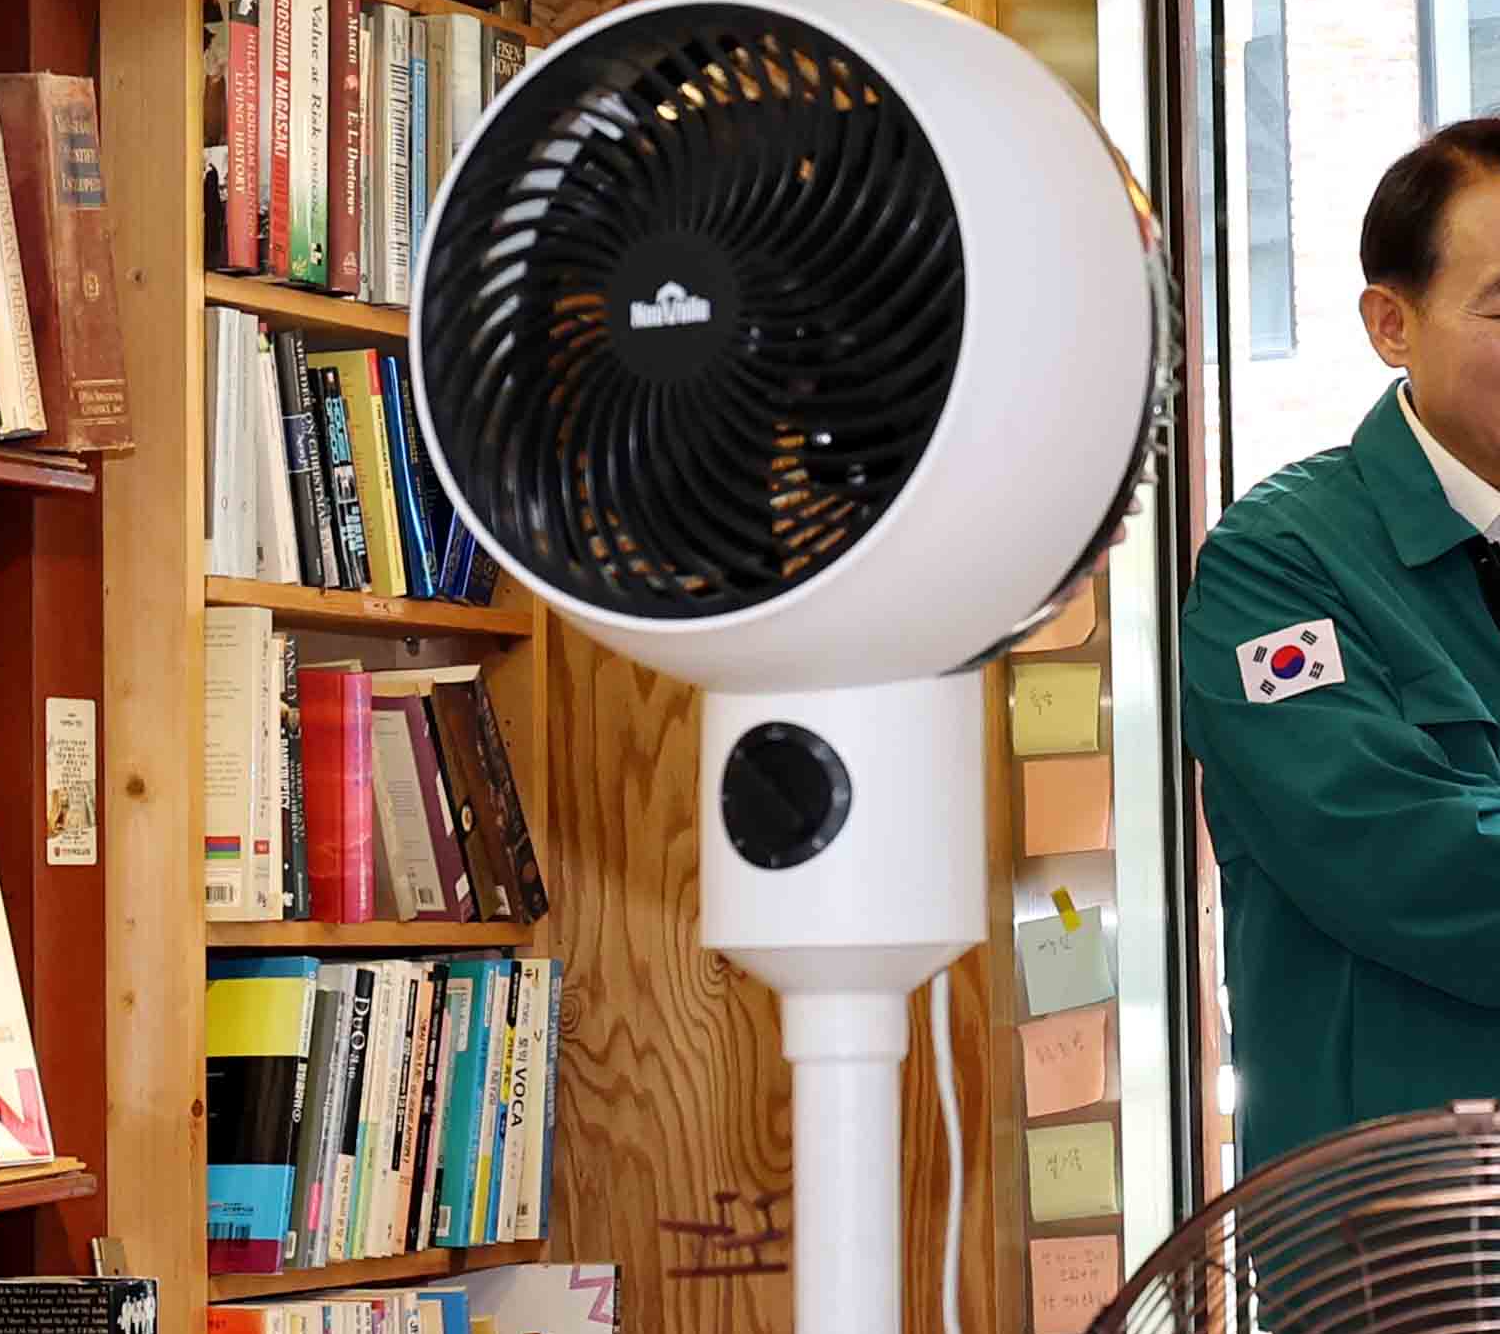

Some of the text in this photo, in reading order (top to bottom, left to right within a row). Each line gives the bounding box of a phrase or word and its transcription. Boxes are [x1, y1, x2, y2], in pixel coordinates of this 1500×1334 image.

[310, 3, 325, 59] Value
[347, 17, 358, 65] MARCH
[235, 71, 246, 195] LIVING HISTORY
[274, 76, 290, 158] NAGASAKI
[310, 94, 323, 140] Risk
[346, 147, 359, 216] Doctorow
[511, 1066, 528, 1127] VOCA
